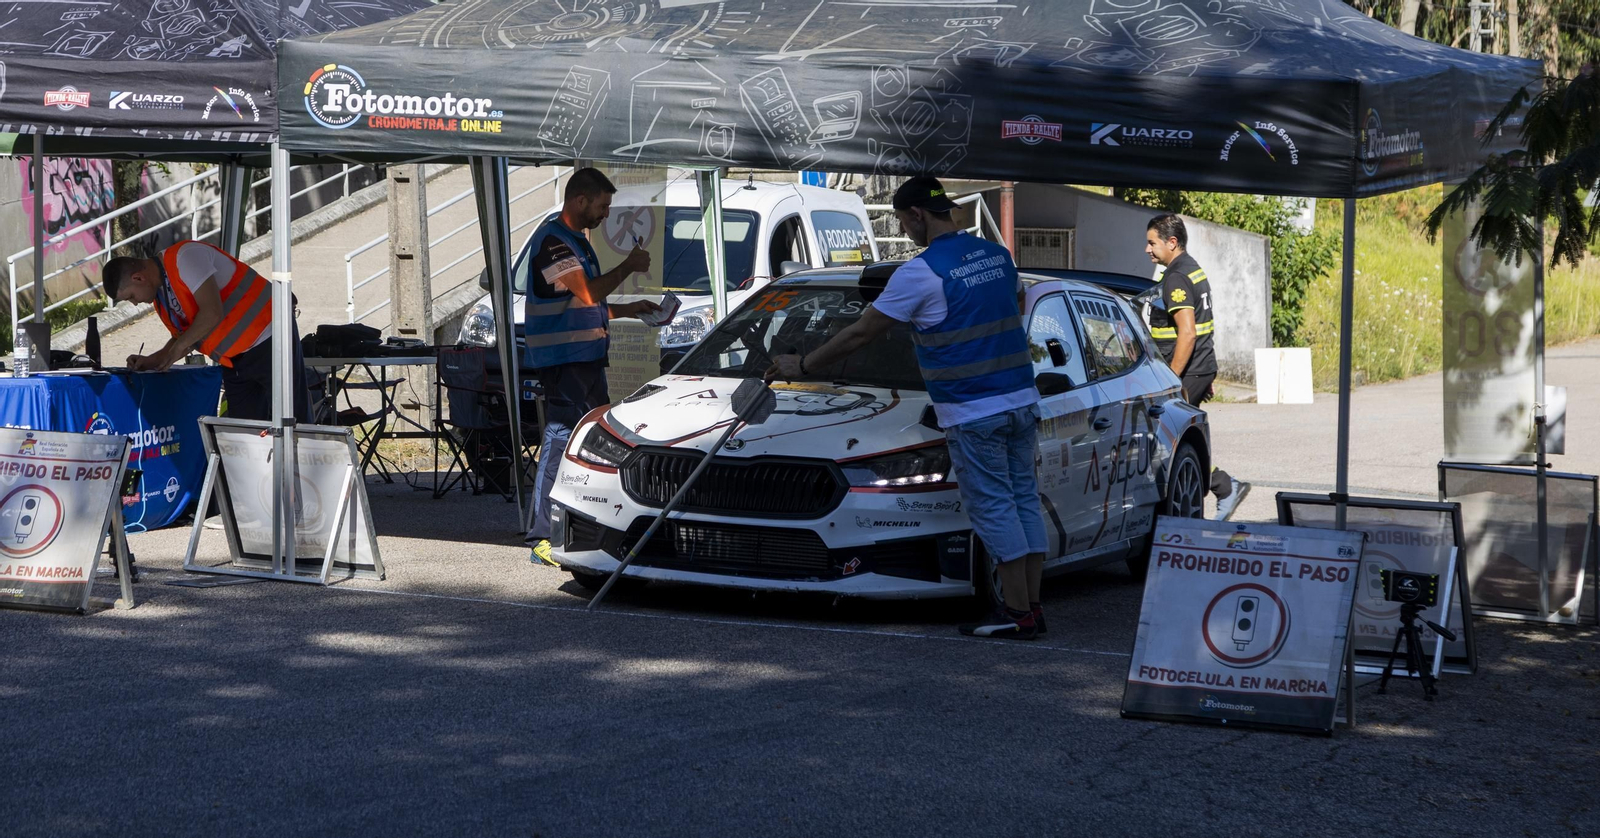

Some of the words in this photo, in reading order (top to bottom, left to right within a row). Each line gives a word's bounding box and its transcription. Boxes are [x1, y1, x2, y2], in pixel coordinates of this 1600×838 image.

[201, 94, 219, 120] Motor
[228, 87, 246, 97] Info
[243, 92, 260, 123] Service
[368, 115, 457, 131] CRONOMETRAJE
[461, 118, 502, 133] ONLINE
[1220, 130, 1240, 161] Motor
[1254, 120, 1277, 132] Info
[1276, 124, 1299, 165] Service
[826, 229, 860, 248] RODOSA
[950, 254, 1007, 280] CRONOMETRADOR
[963, 267, 1005, 288] TIMEKEEPER
[753, 291, 804, 312] 15
[51, 466, 71, 481] EL
[75, 465, 112, 482] PASO
[582, 495, 609, 504] MICHELIN
[16, 565, 34, 577] EN
[36, 566, 84, 578] MARCHA
[1157, 551, 1263, 577] PROHIBIDO
[1269, 561, 1292, 578] EL
[1299, 565, 1350, 583] PASO
[1138, 665, 1235, 688] FOTOCELULA
[1239, 677, 1262, 689] EN
[1264, 678, 1328, 694] MARCHA
[1204, 698, 1255, 712] Fotomotor
